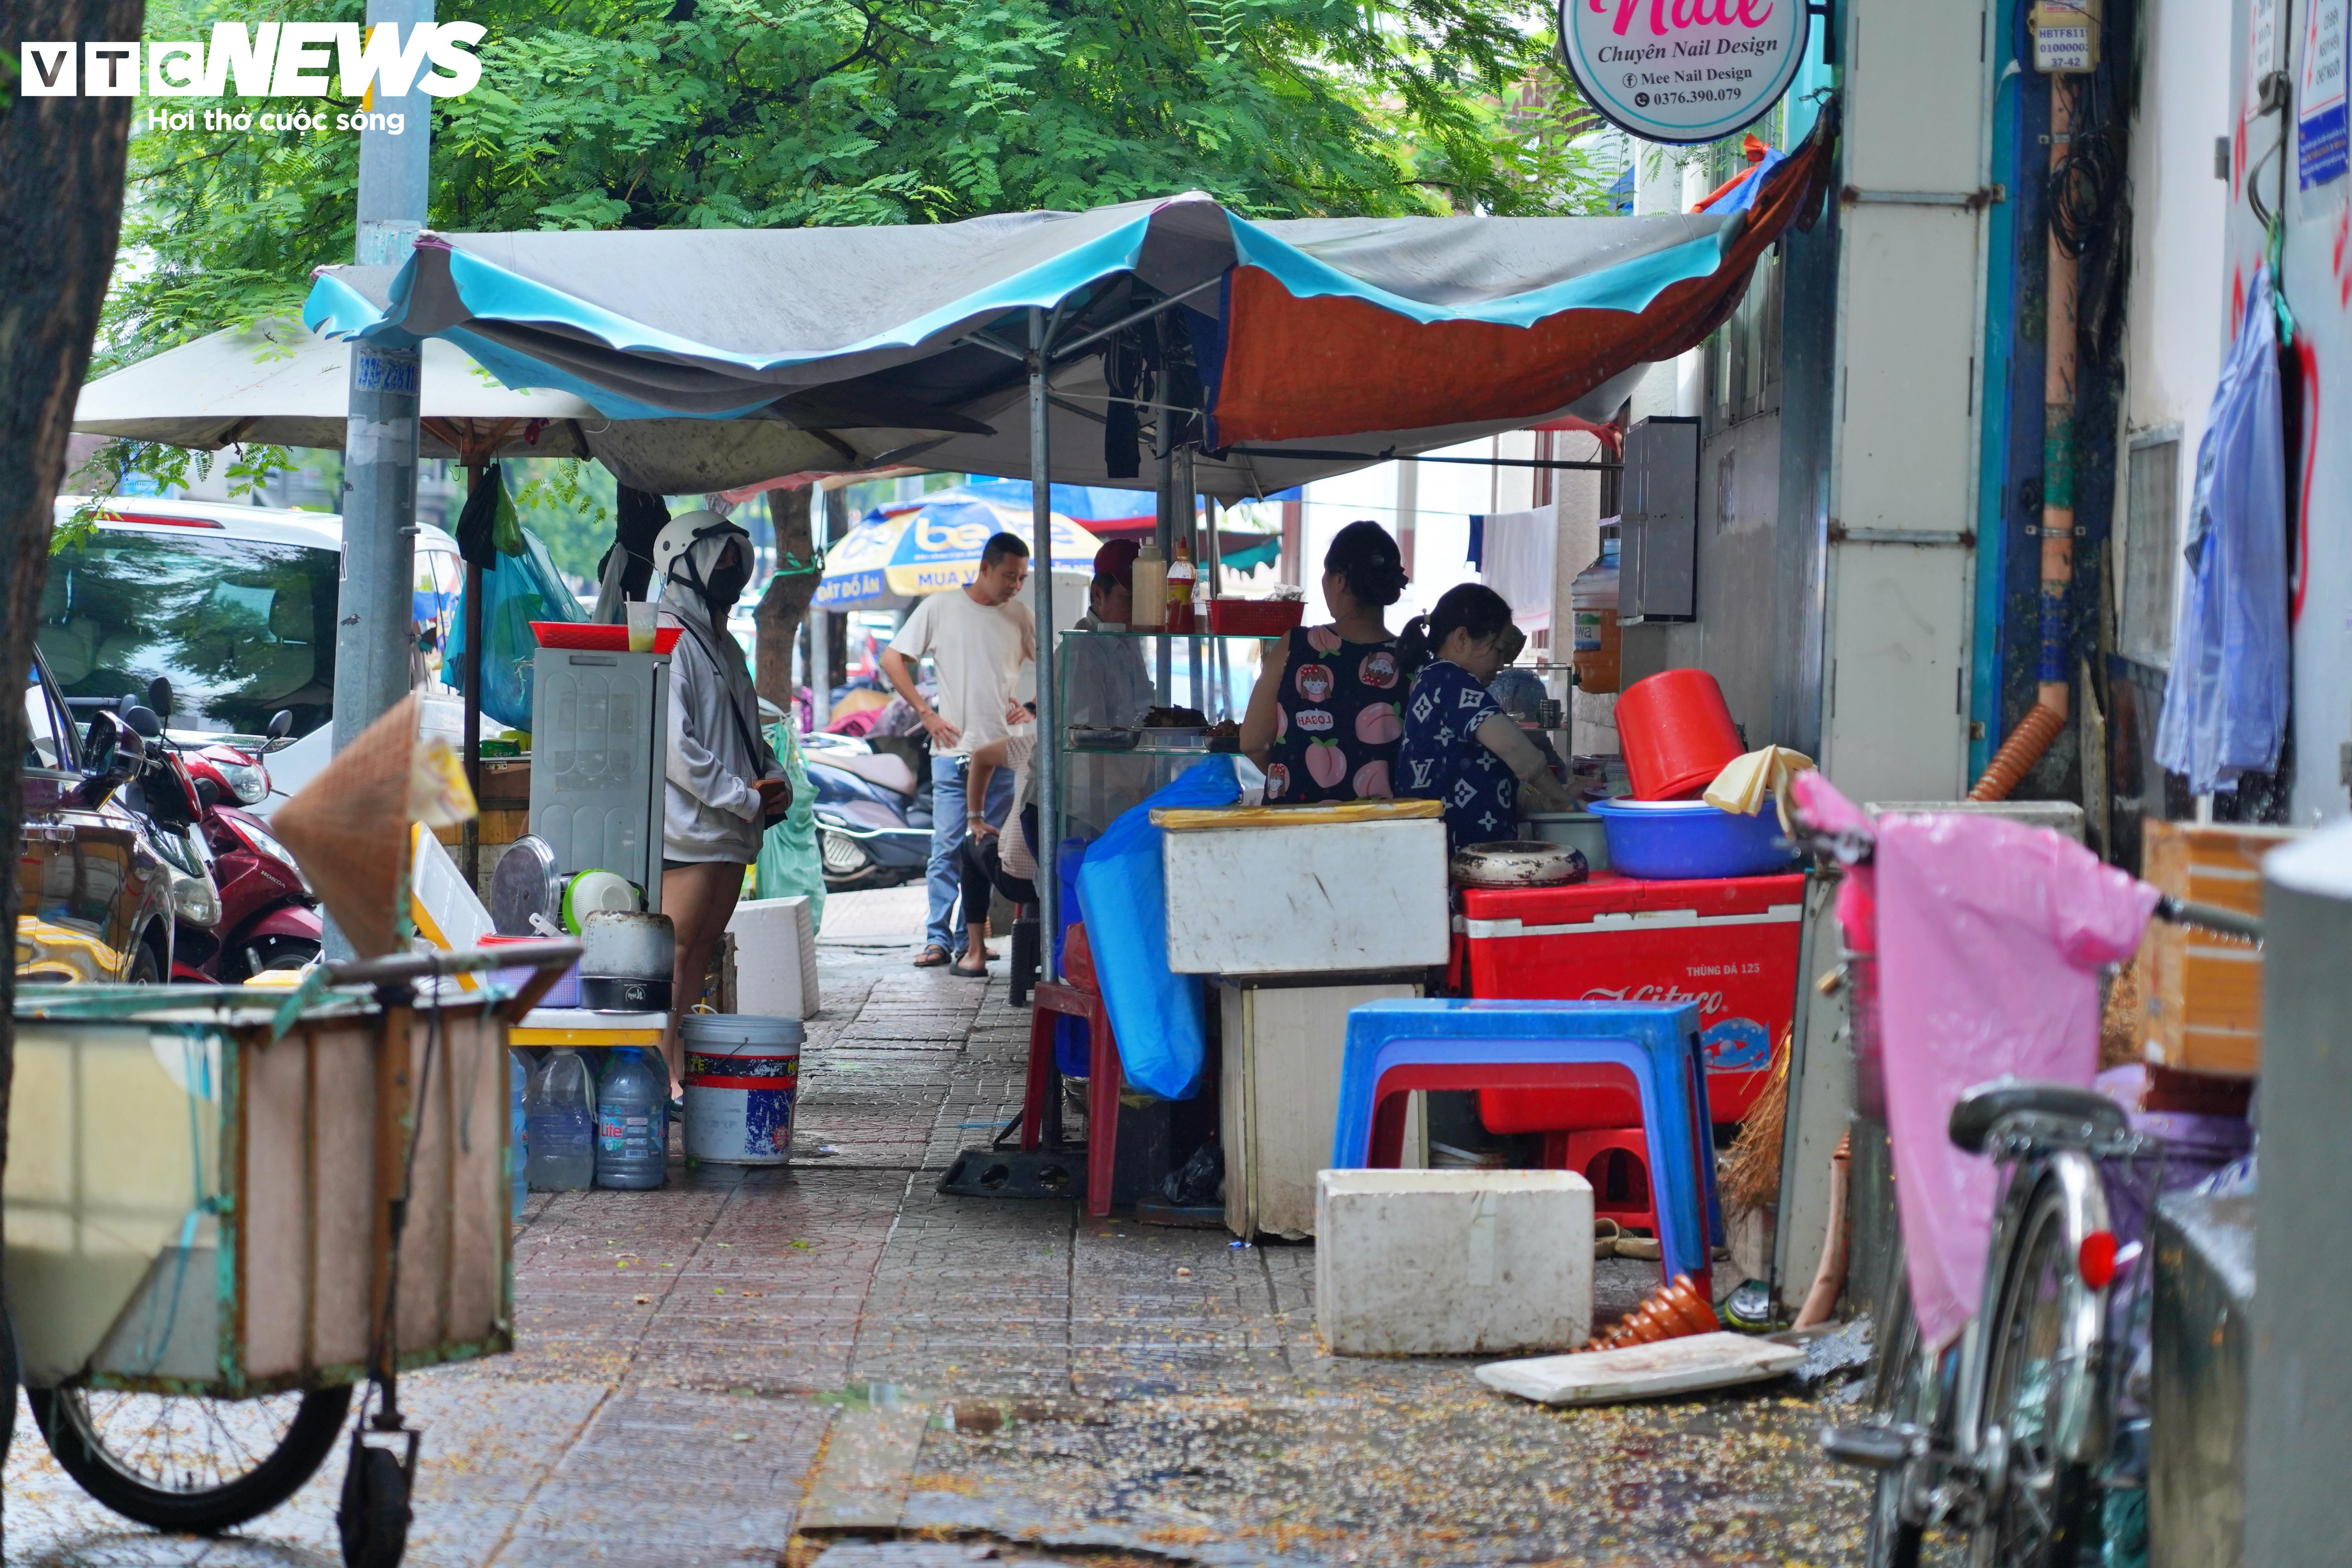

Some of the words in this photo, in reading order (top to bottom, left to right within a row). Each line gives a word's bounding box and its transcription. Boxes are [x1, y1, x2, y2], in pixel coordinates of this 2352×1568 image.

[2040, 29, 2087, 38] HBTF811
[1598, 44, 1666, 64] Chuyên
[1672, 40, 1710, 58] Nail
[1716, 37, 1778, 55] Design
[2051, 58, 2080, 67] 37-42
[1641, 73, 1670, 85] Mee
[1674, 70, 1702, 83] Nail
[1707, 67, 1753, 81] Design
[1654, 88, 1741, 105] 0376.390.079
[915, 517, 990, 552] be
[918, 572, 959, 586] MUA
[965, 570, 979, 584] V
[817, 580, 840, 604] ĐẶT
[842, 573, 861, 597] ĐỒ
[862, 575, 880, 595] ĂN
[260, 870, 286, 889] HONDA
[1687, 963, 1721, 976] THÙNG
[1724, 962, 1737, 975] ĐÁ
[601, 1122, 623, 1138] Life
